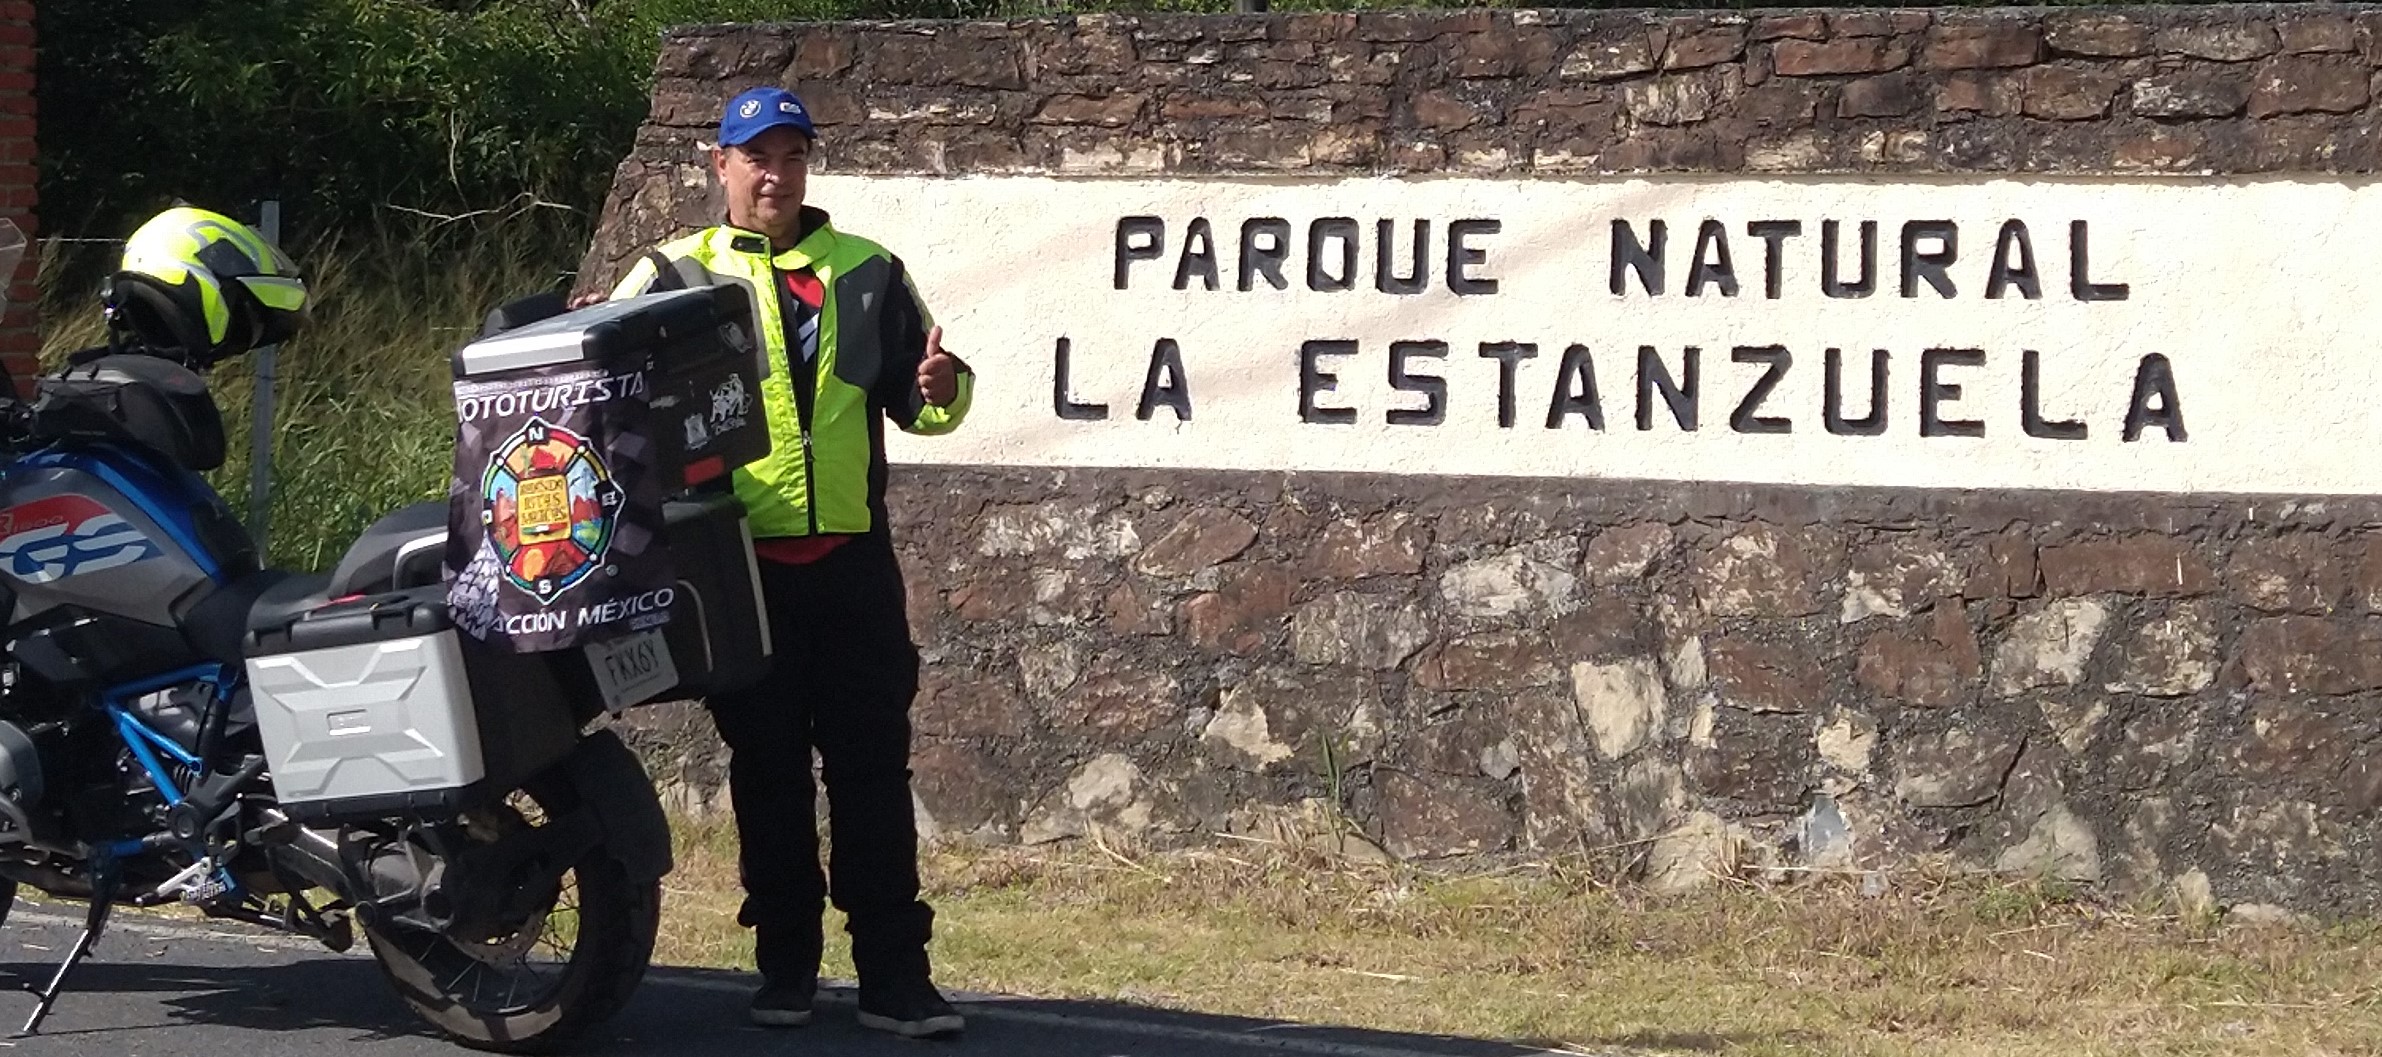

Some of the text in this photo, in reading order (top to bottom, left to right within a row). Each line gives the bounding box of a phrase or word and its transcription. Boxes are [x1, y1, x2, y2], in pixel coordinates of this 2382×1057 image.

[1113, 216, 2130, 302] PARQUE NATURAL
[458, 371, 645, 422] OTOTURISTA
[1053, 336, 2187, 443] LA ESTANZUELA
[529, 427, 544, 441] N
[0, 512, 148, 584] GS
[538, 580, 552, 595] S
[577, 588, 675, 627] MÉXICO
